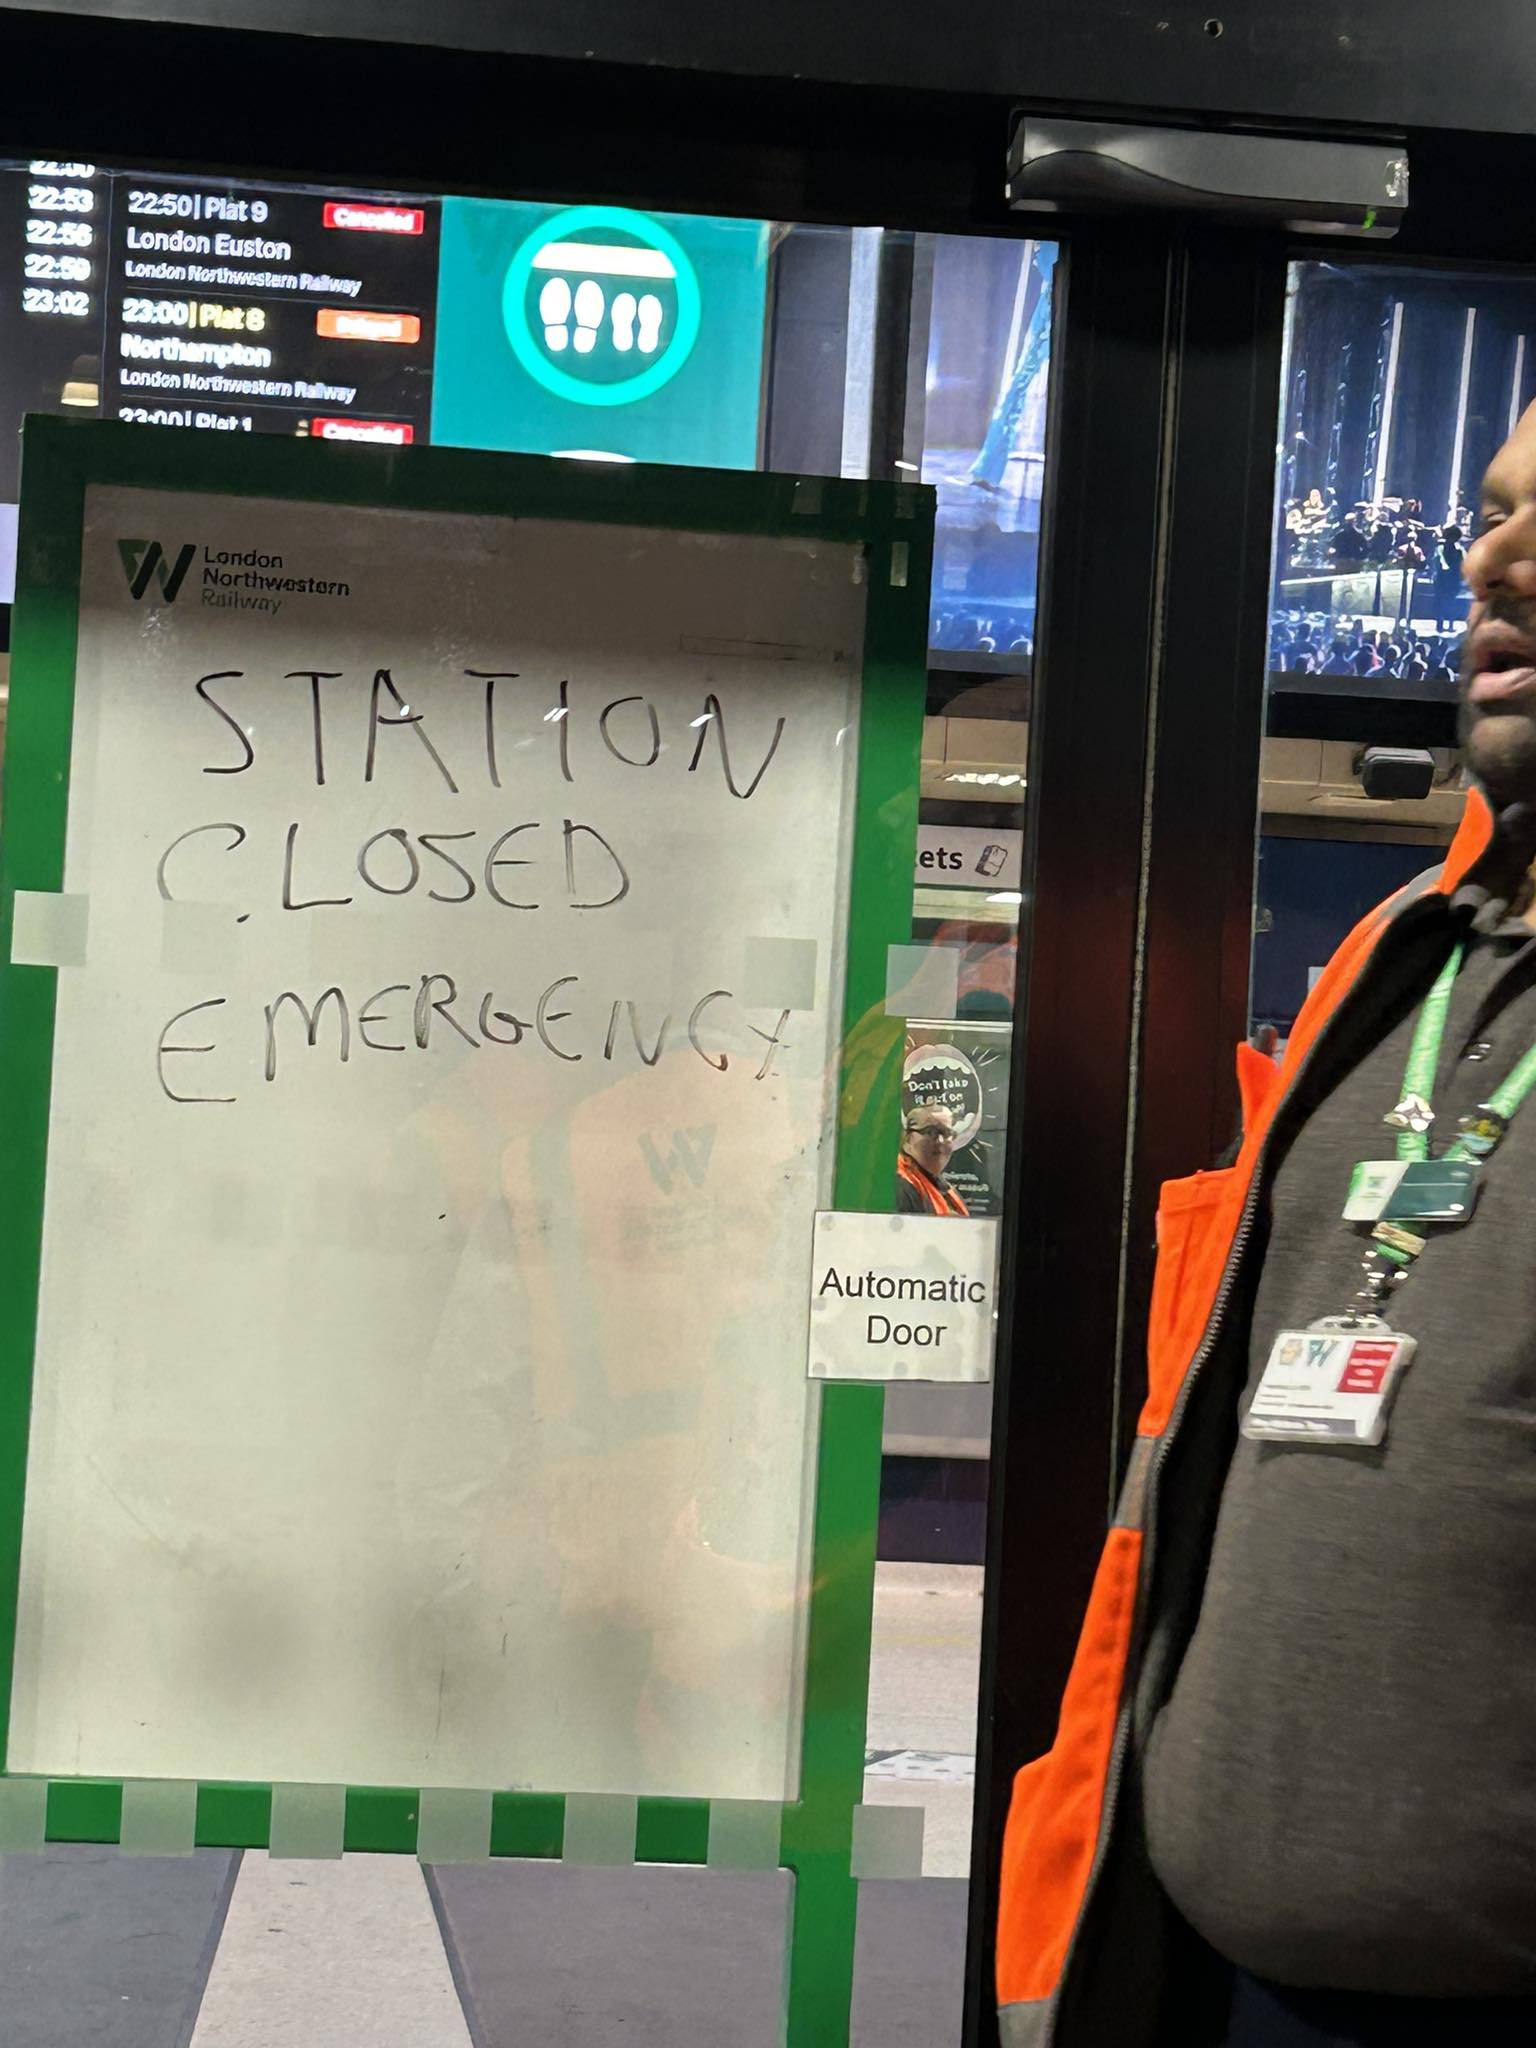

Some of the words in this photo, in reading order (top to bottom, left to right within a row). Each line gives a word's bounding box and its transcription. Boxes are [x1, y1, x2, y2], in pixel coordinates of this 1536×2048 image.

[205, 196, 248, 222] Plat
[251, 200, 268, 223] 9
[127, 226, 210, 254] London
[215, 233, 292, 261] Euston
[125, 260, 186, 280] London
[188, 264, 298, 290] Northwestern
[300, 272, 362, 297] Railway
[22, 287, 89, 316] 23:02
[200, 303, 245, 330] Plat
[120, 332, 272, 369] Northampton
[120, 369, 181, 389] London
[183, 373, 293, 397] Northwestern
[294, 380, 357, 405] Railway
[204, 546, 283, 569] London
[203, 568, 350, 597] Northwestern
[201, 588, 282, 615] Railway
[195, 668, 786, 800] STATION
[156, 818, 632, 923] CLOSED
[915, 847, 963, 870] ets
[156, 973, 793, 1104] EMERGENCY
[819, 1267, 986, 1303] Automatic
[867, 1315, 948, 1346] Door
